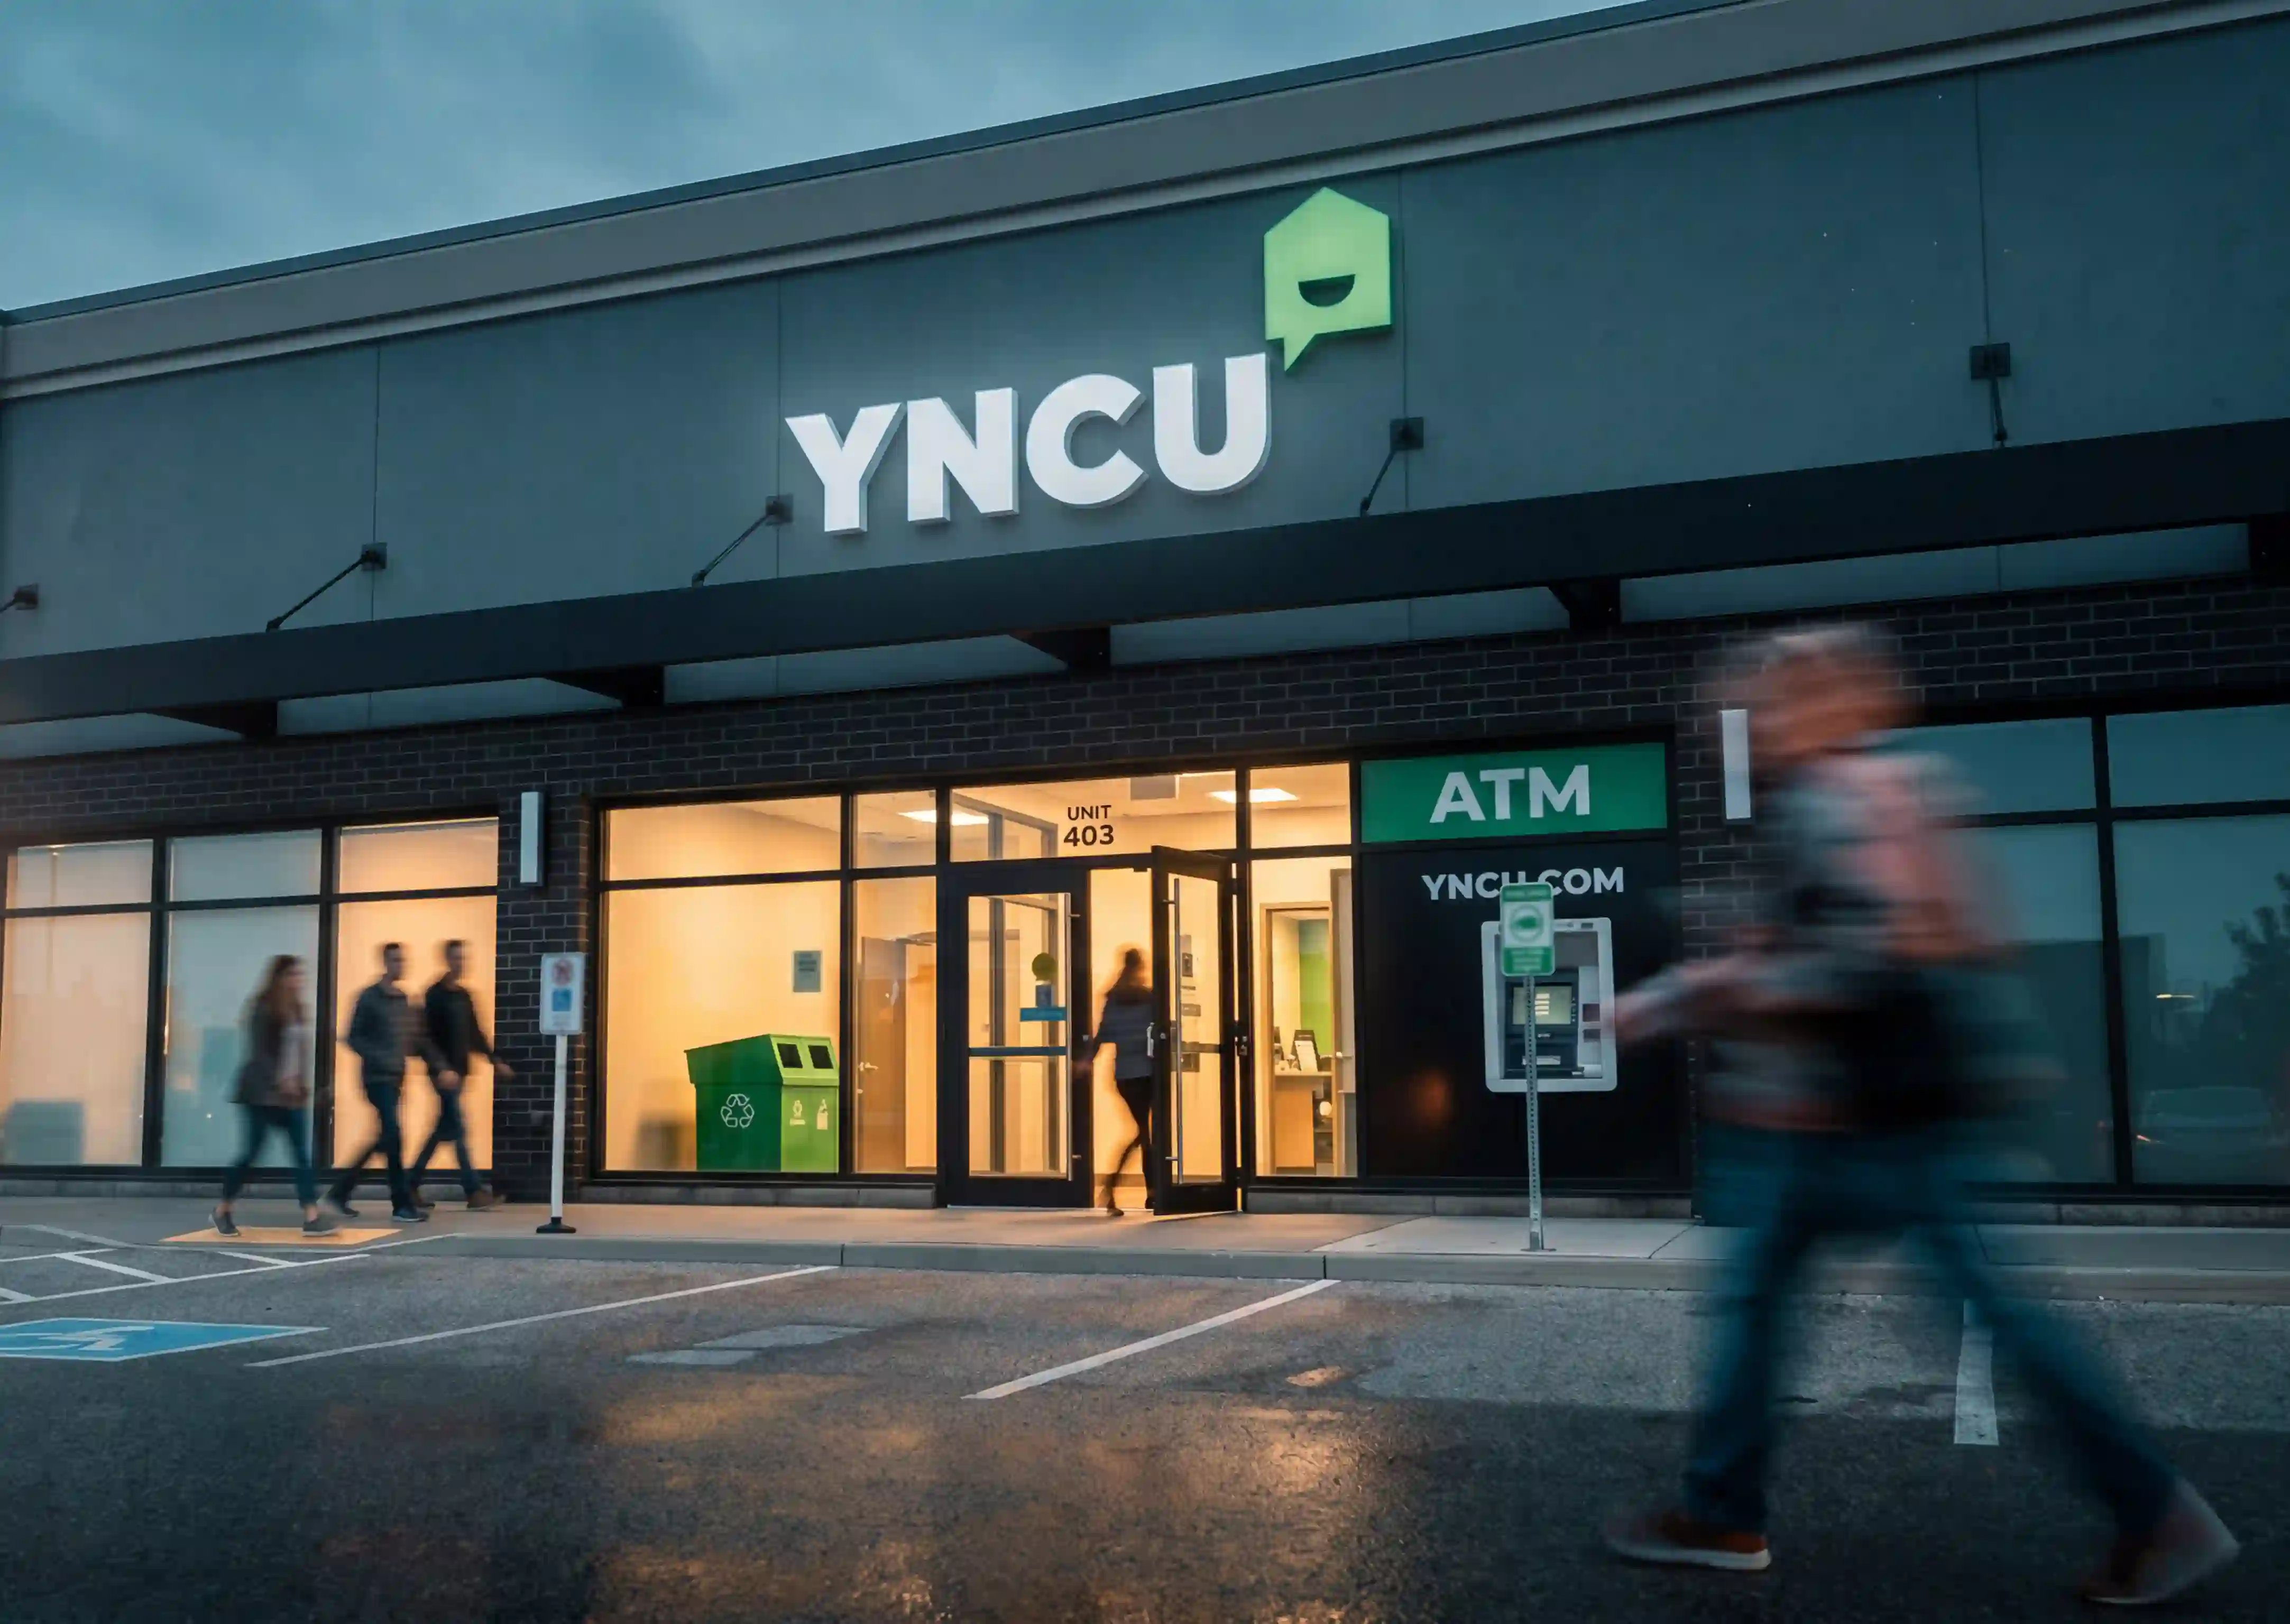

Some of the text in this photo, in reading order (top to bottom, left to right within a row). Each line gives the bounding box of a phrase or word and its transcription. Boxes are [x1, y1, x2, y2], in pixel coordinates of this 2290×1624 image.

[785, 353, 1271, 536] YNCU
[1068, 805, 1112, 821] UNIT
[1429, 764, 1590, 823] ATM
[1063, 825, 1114, 847] 403
